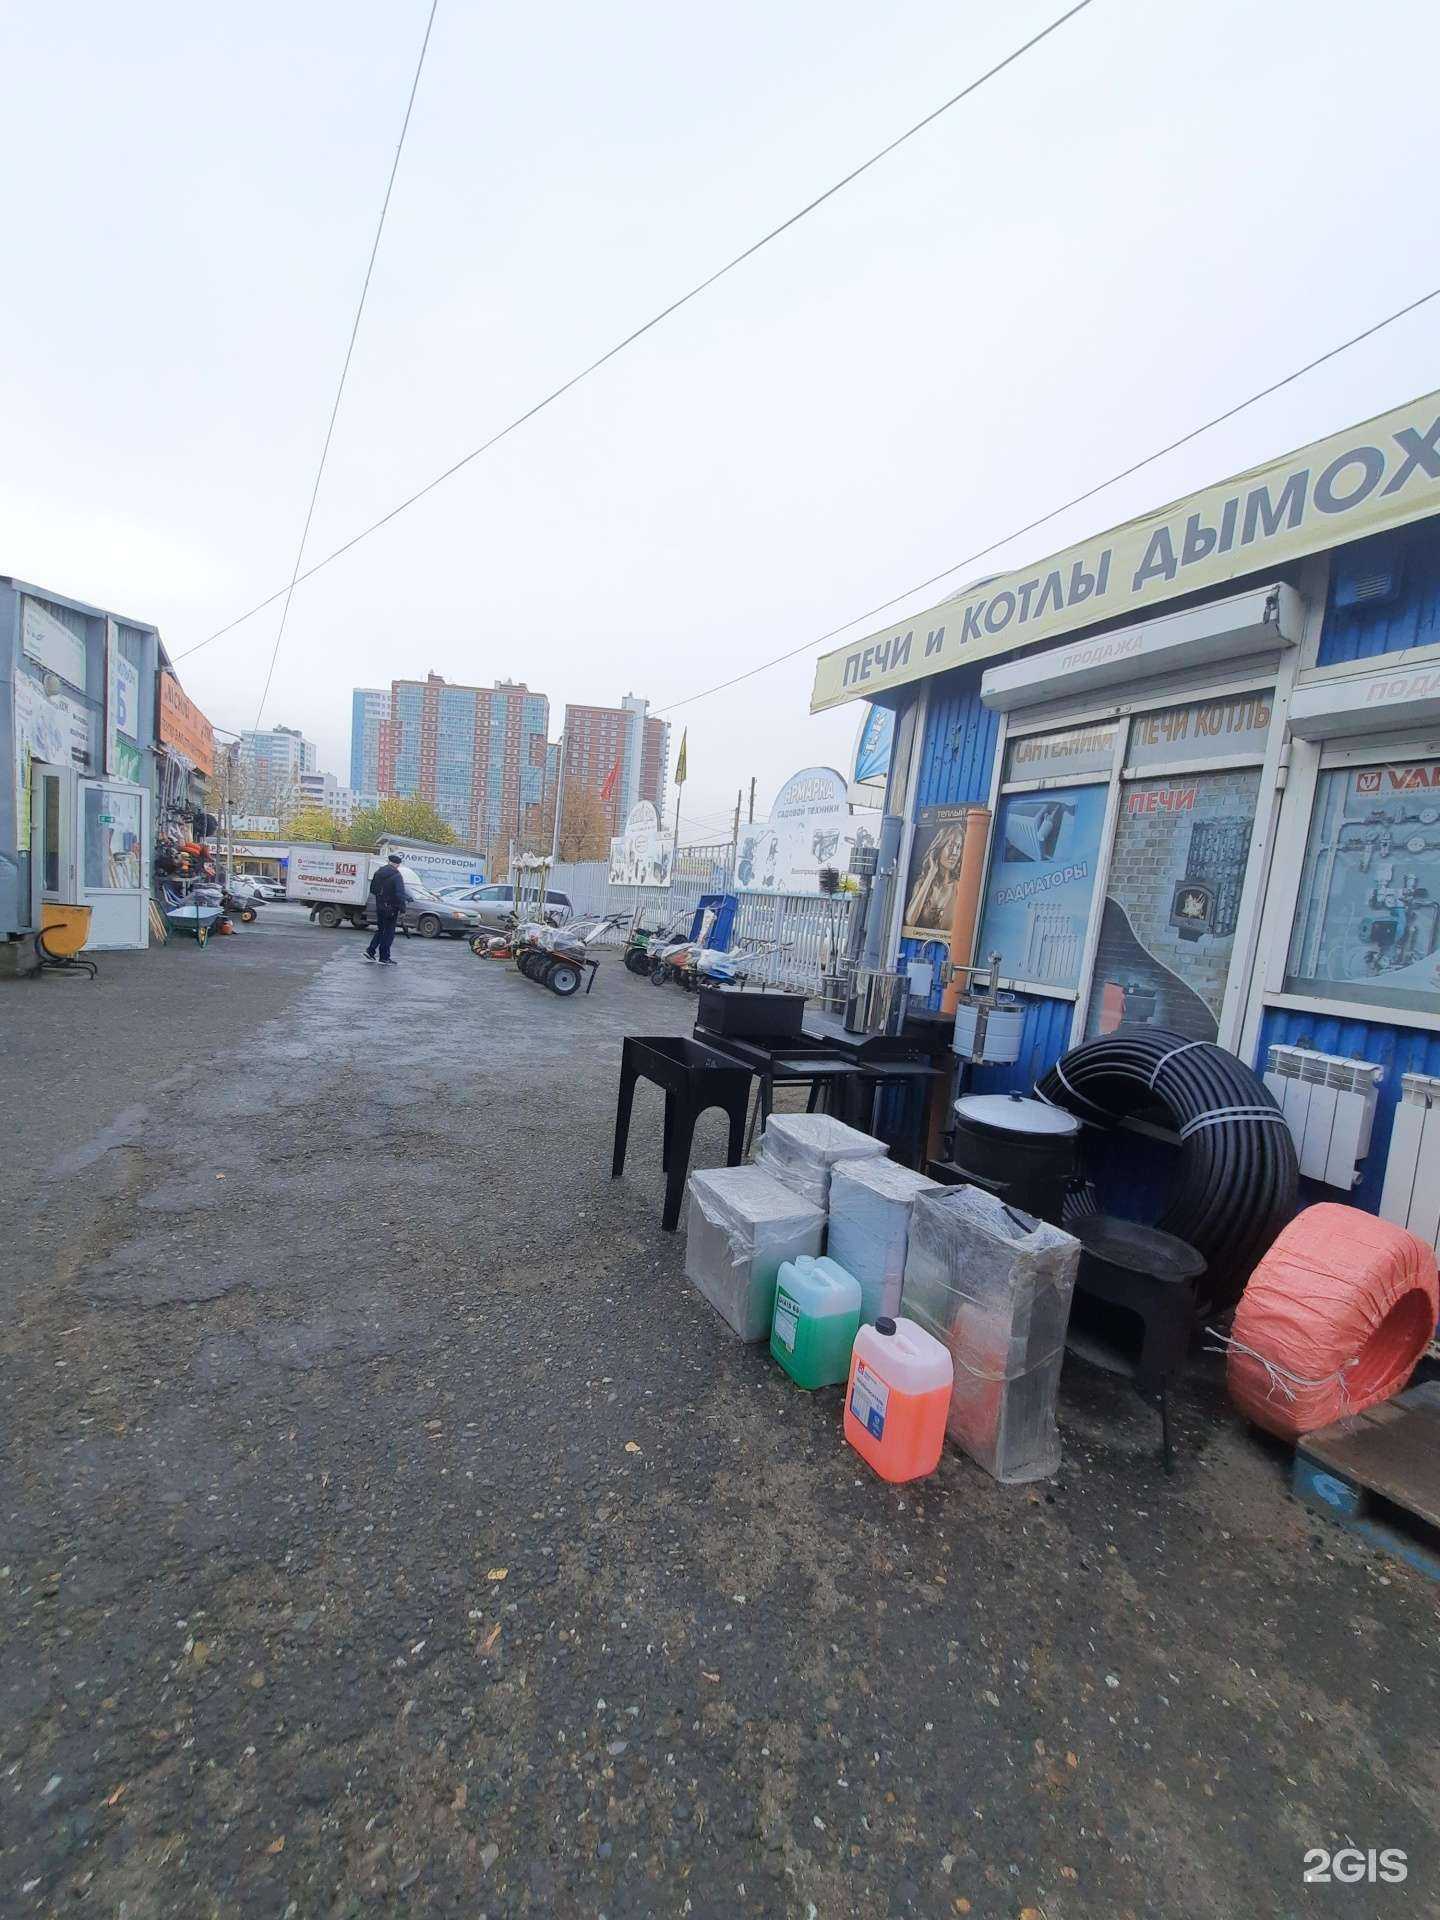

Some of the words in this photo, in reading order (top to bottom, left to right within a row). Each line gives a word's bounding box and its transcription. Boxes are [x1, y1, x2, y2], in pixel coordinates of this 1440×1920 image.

[842, 630, 914, 688] ПЕЧИ
[923, 626, 946, 658] и
[960, 549, 1113, 645] КОТЛЫ
[1131, 416, 1440, 593] ДЫМОХ
[1061, 633, 1144, 670] ПРОДАЖА
[1133, 709, 1190, 746] ПЕЧИ
[1127, 788, 1197, 814] ПЕЧИ
[399, 851, 477, 869] Электротовары
[996, 860, 1089, 906] РАДИАТОРЫ
